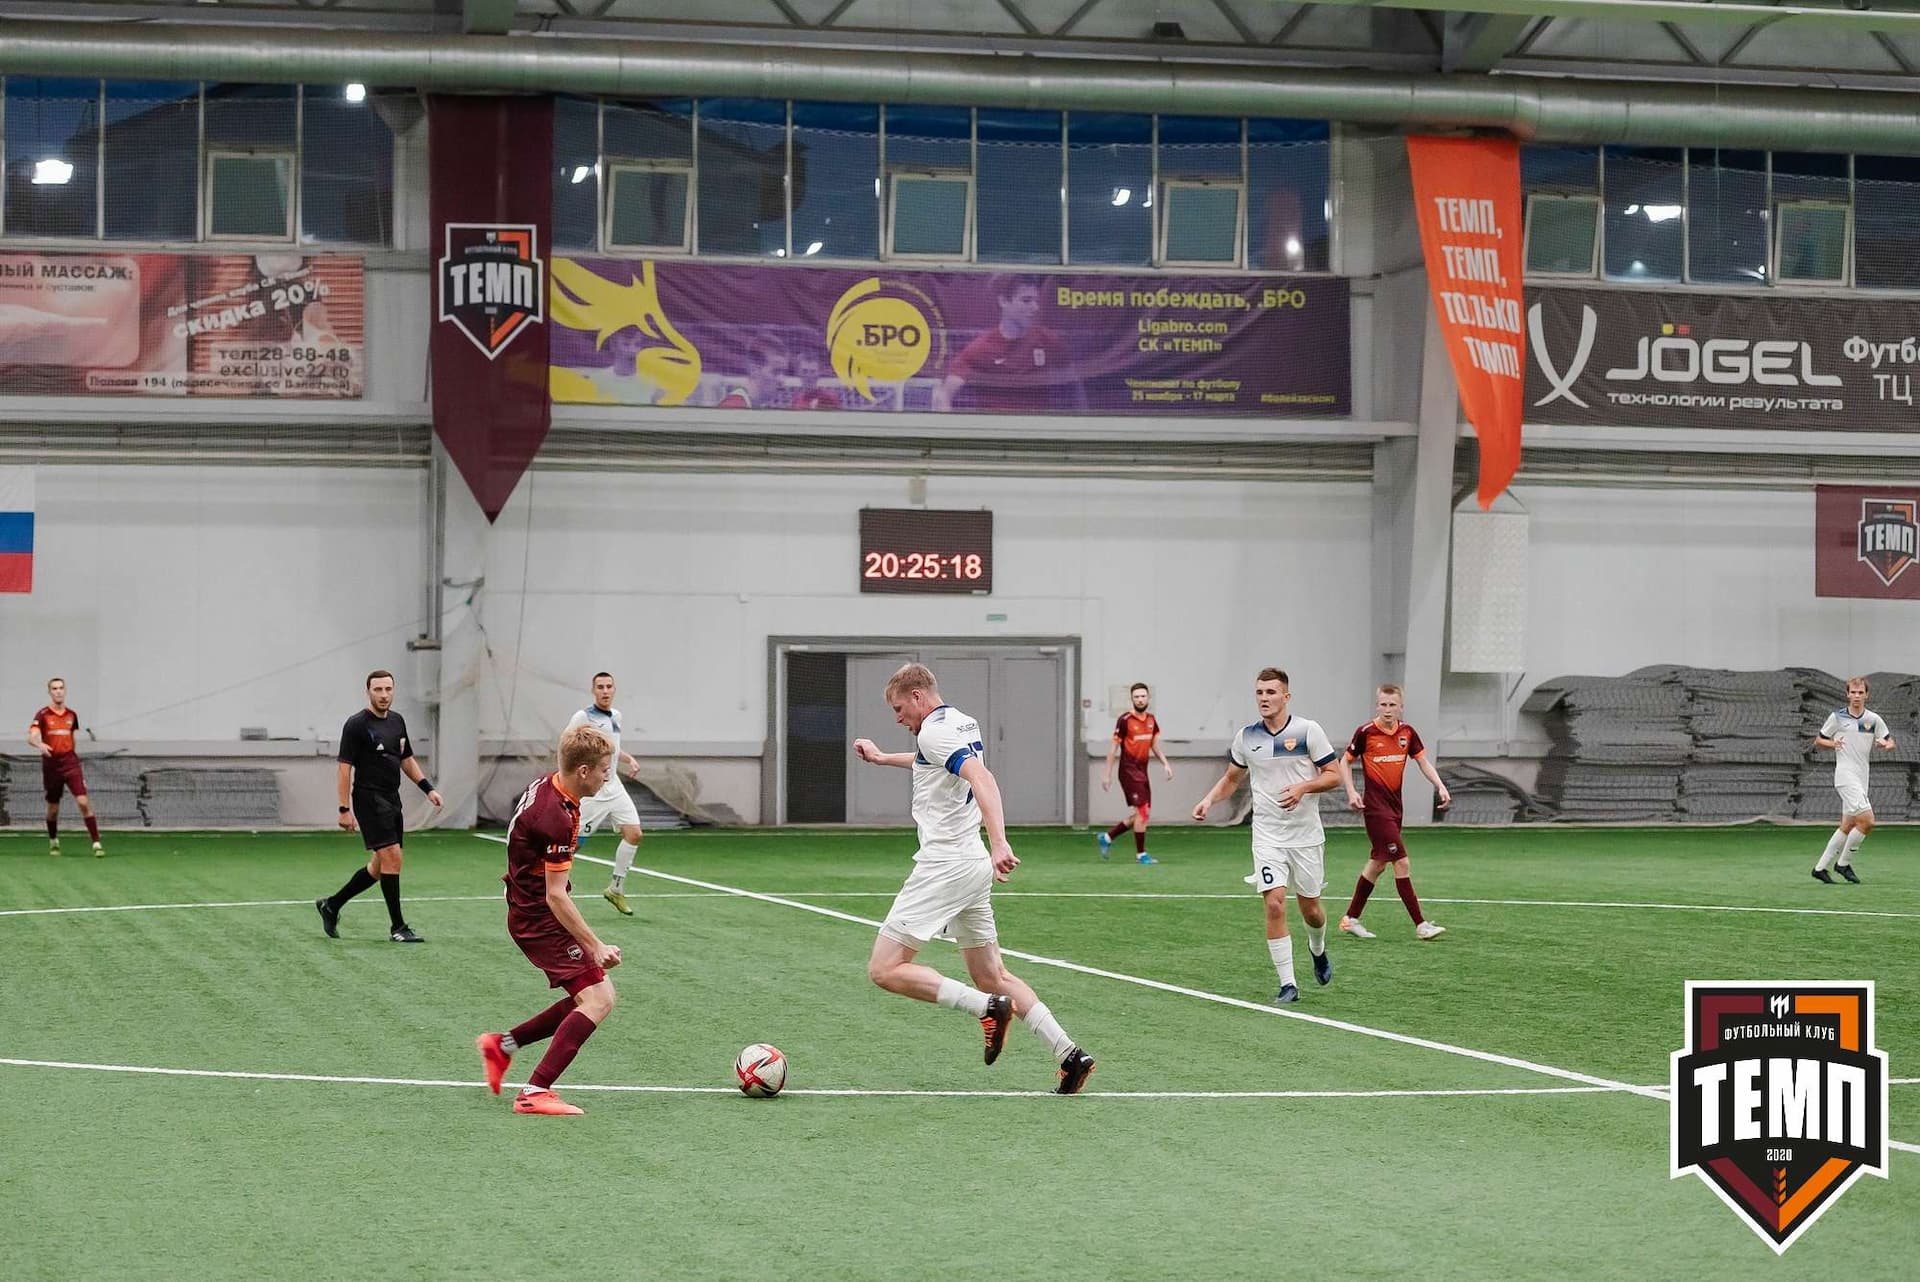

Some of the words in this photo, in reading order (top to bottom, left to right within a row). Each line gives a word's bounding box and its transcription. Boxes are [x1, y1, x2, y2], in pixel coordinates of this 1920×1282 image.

[1435, 197, 1502, 239] ТЕМП,
[0, 261, 34, 277] ЫЙ
[41, 264, 133, 280] МАССАЖ:
[1441, 245, 1507, 288] ТЕМП,
[450, 262, 533, 308] ТЕМП
[173, 300, 267, 338] скидка
[271, 278, 330, 311] 20%
[1057, 287, 1124, 309] Время
[1130, 287, 1250, 311] побеждать,
[1440, 292, 1520, 334] ТОЛЬКО
[856, 324, 921, 347] .БРО
[1138, 319, 1228, 336] Ligabro.com
[1138, 339, 1159, 352] СК
[1164, 338, 1222, 352] «ТЕМП»
[1605, 323, 1843, 387] JÖGEL
[1843, 335, 1920, 369] Футб
[143, 377, 167, 388] 194
[1872, 374, 1912, 406] ТЦ
[1607, 392, 1726, 408] технологии
[1729, 393, 1843, 411] результата
[1864, 523, 1914, 554] ТЕМП
[864, 552, 982, 579] 20:25:18
[584, 821, 592, 833] 5
[1261, 866, 1274, 884] 6
